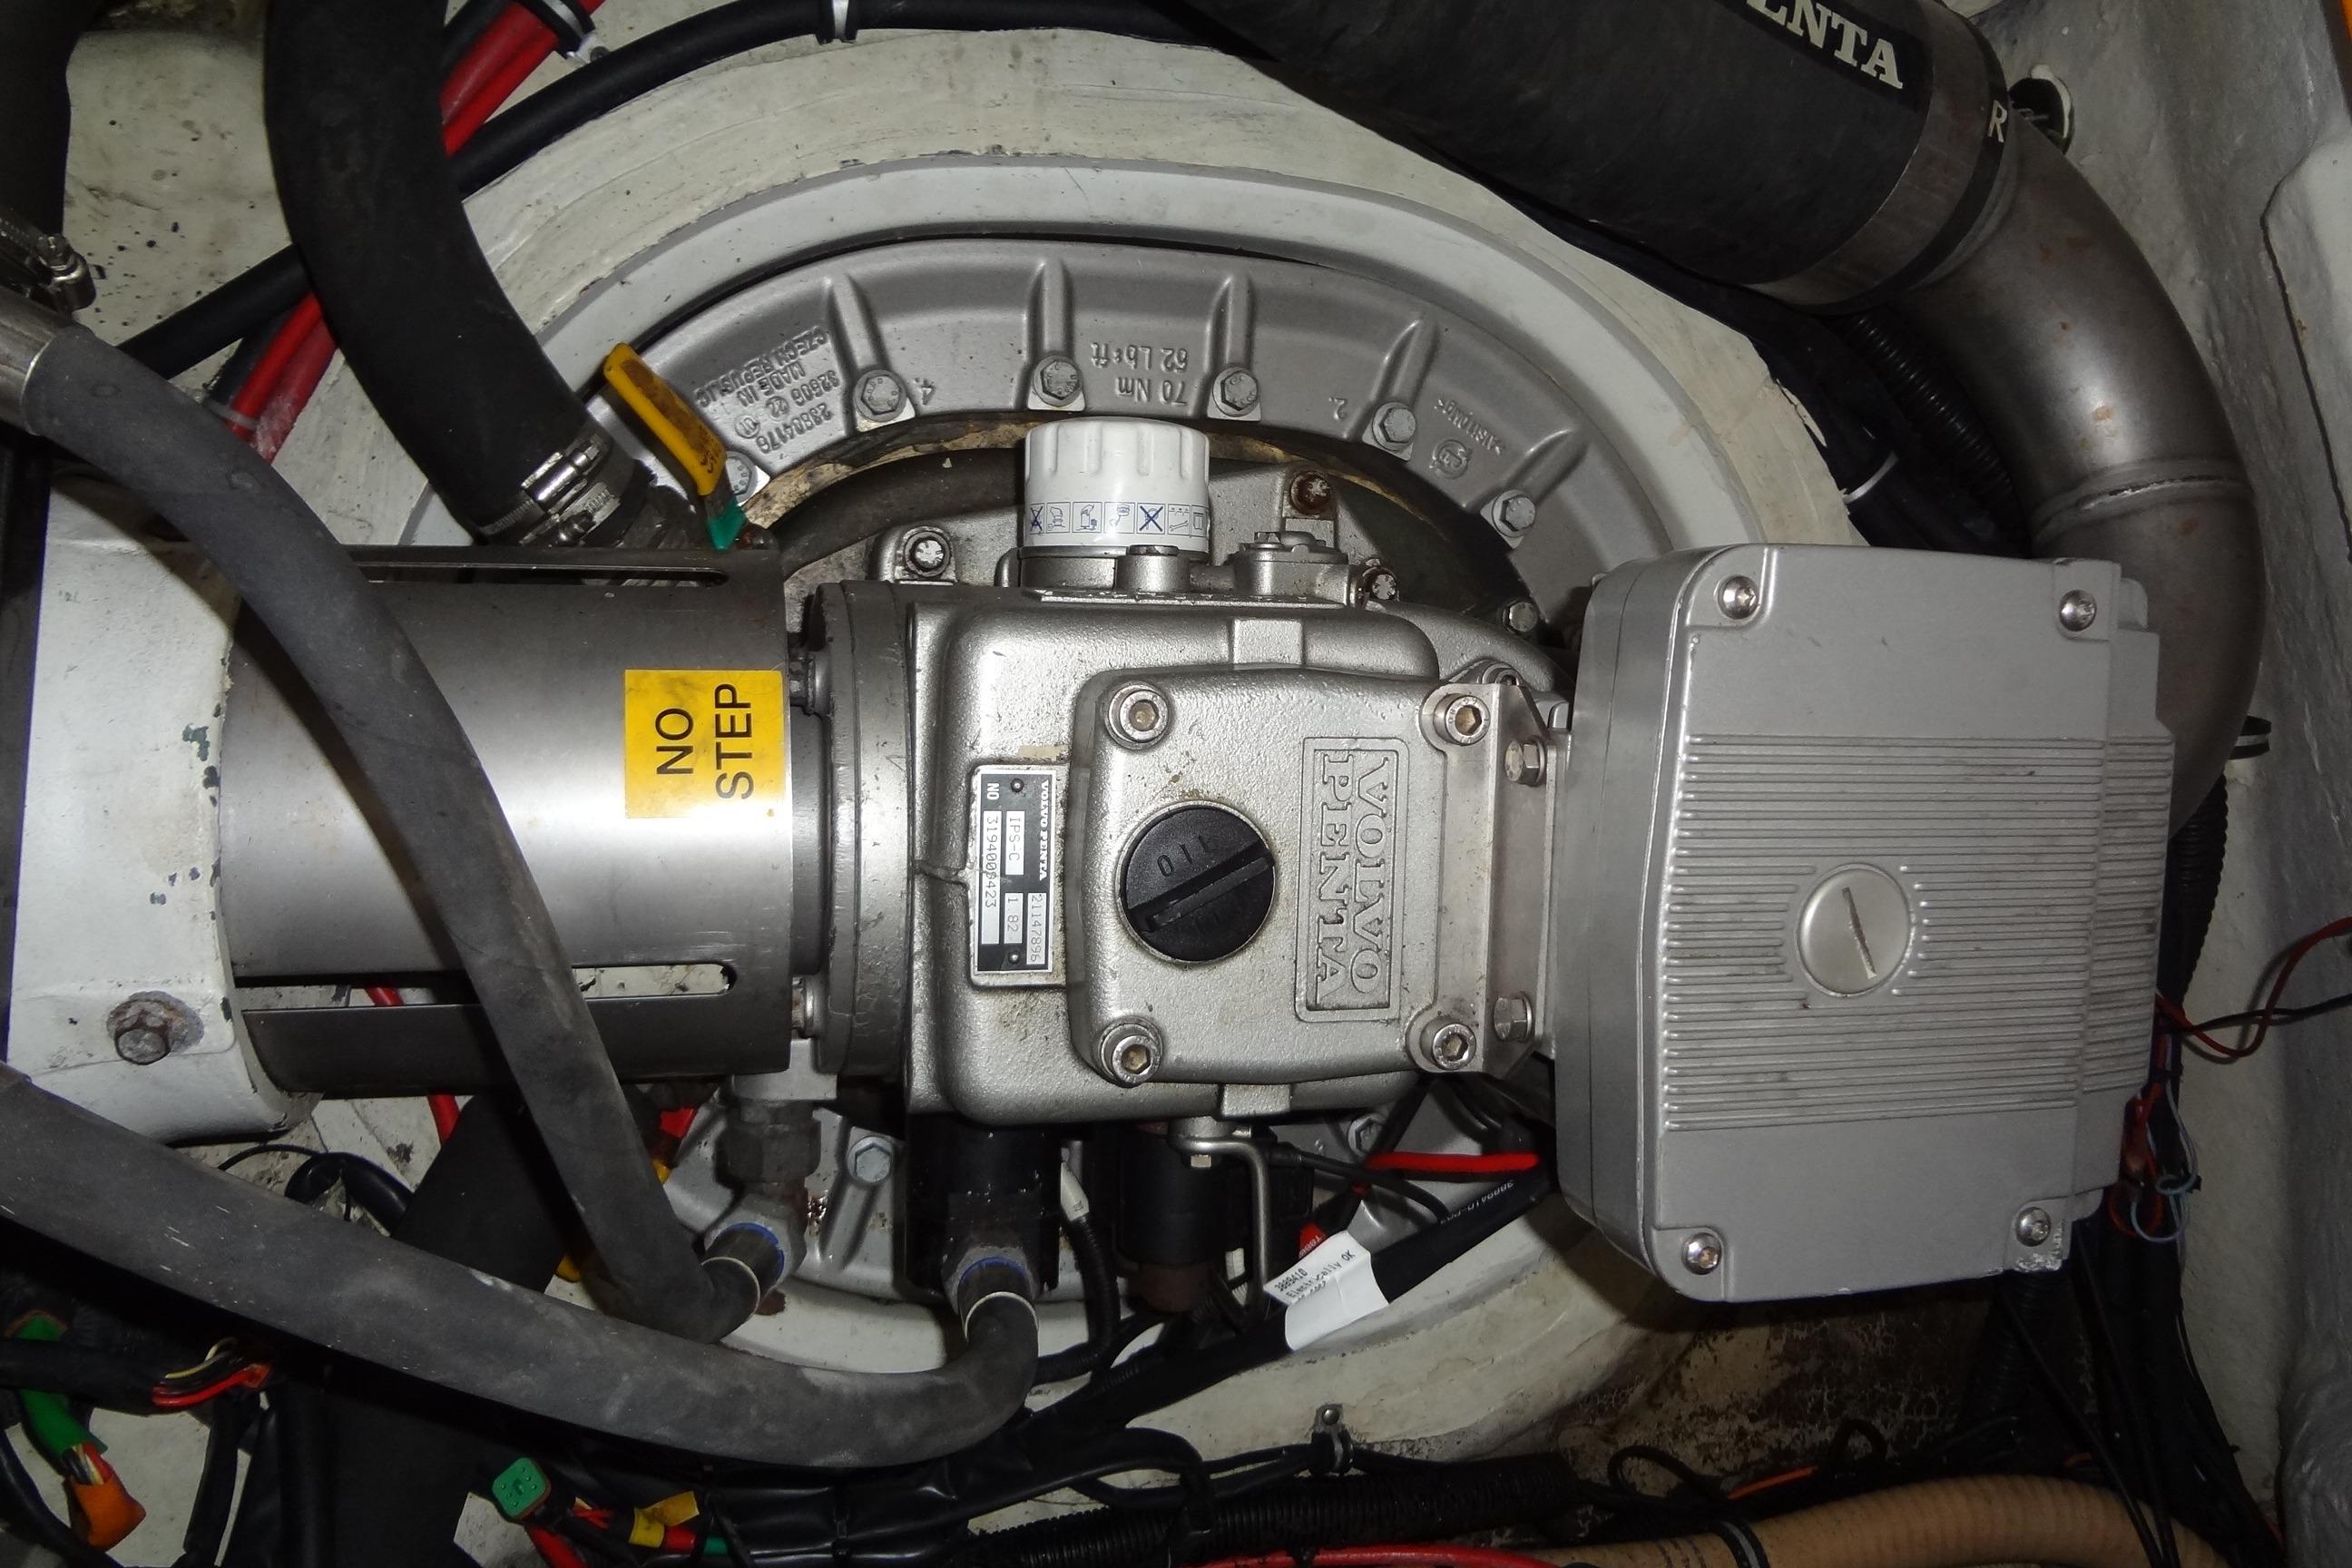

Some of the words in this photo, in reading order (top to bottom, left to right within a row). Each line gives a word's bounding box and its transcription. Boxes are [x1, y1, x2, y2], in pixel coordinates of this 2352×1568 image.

[1988, 100, 2008, 144] R
[777, 329, 829, 356] CZECH
[736, 384, 760, 407] IN
[759, 363, 806, 396] MADE
[1115, 377, 1152, 404] Nm
[1158, 379, 1188, 408] 70
[654, 708, 694, 775] NO
[714, 683, 754, 799] STEP
[986, 782, 1000, 800] NO
[1040, 779, 1050, 828] VOLVO
[1008, 816, 1022, 861] IPS-C
[1039, 829, 1049, 881] PENTA
[1157, 834, 1216, 877] OIL
[1315, 754, 1355, 1004] PENTA
[1349, 757, 1390, 994] VOLVO
[1029, 894, 1044, 963] 21147896
[1341, 1249, 1356, 1263] OK
